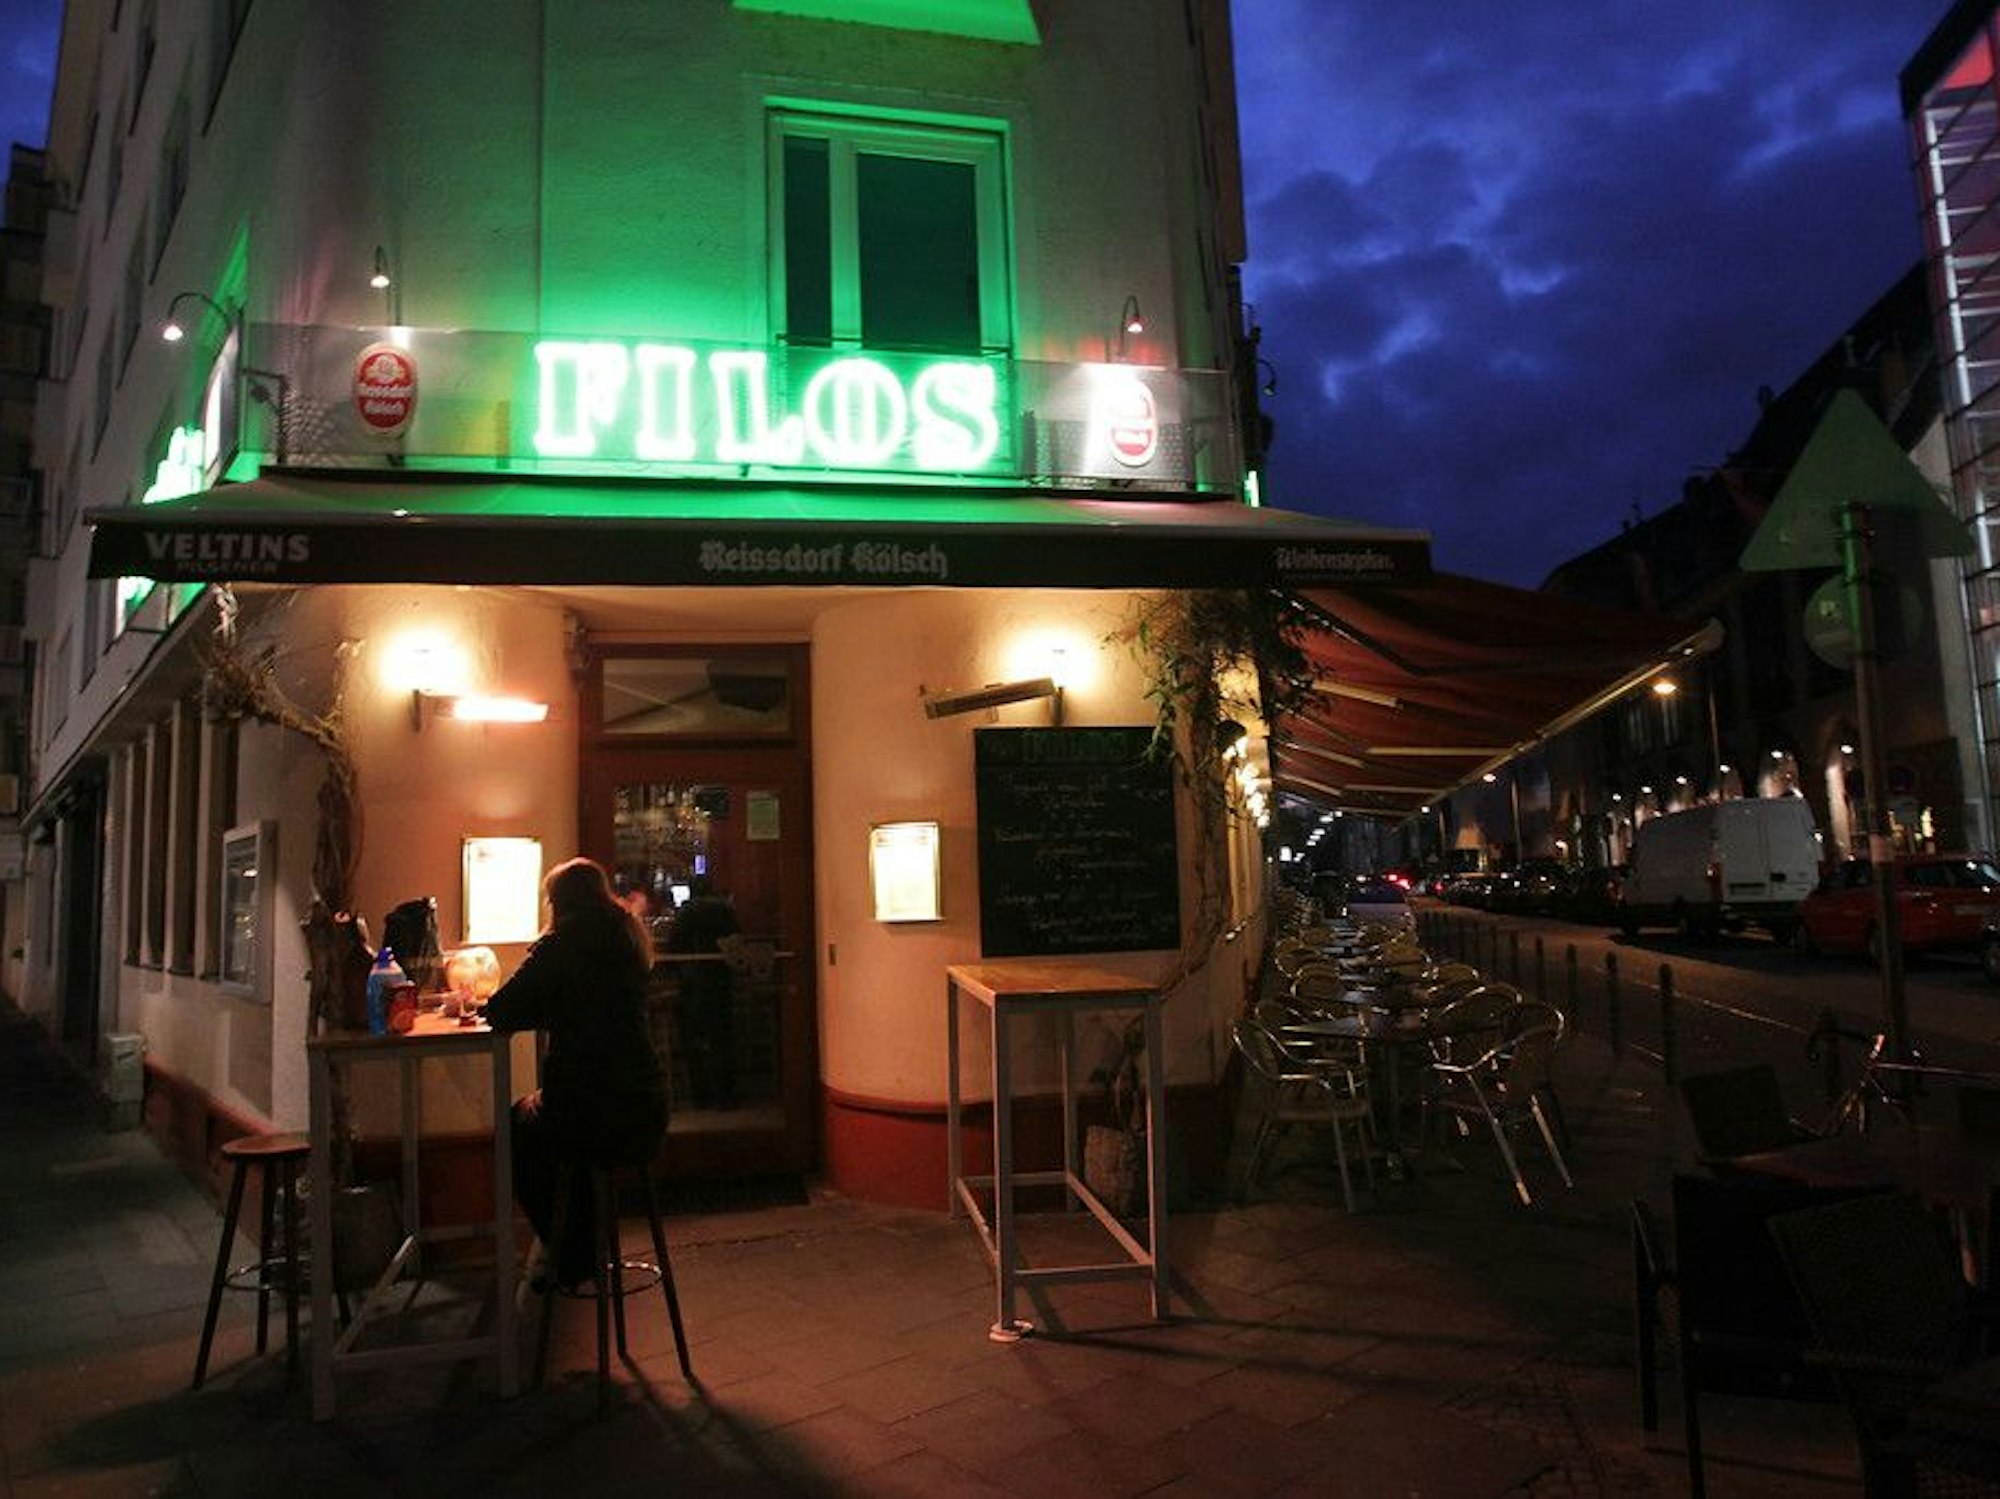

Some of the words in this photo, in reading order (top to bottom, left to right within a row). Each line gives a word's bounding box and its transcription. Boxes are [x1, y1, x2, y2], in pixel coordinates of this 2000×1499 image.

[533, 339, 1000, 471] FILOS
[144, 531, 311, 562] VELTINS
[699, 540, 844, 572] Reissdorf
[849, 541, 948, 580] Kölsch
